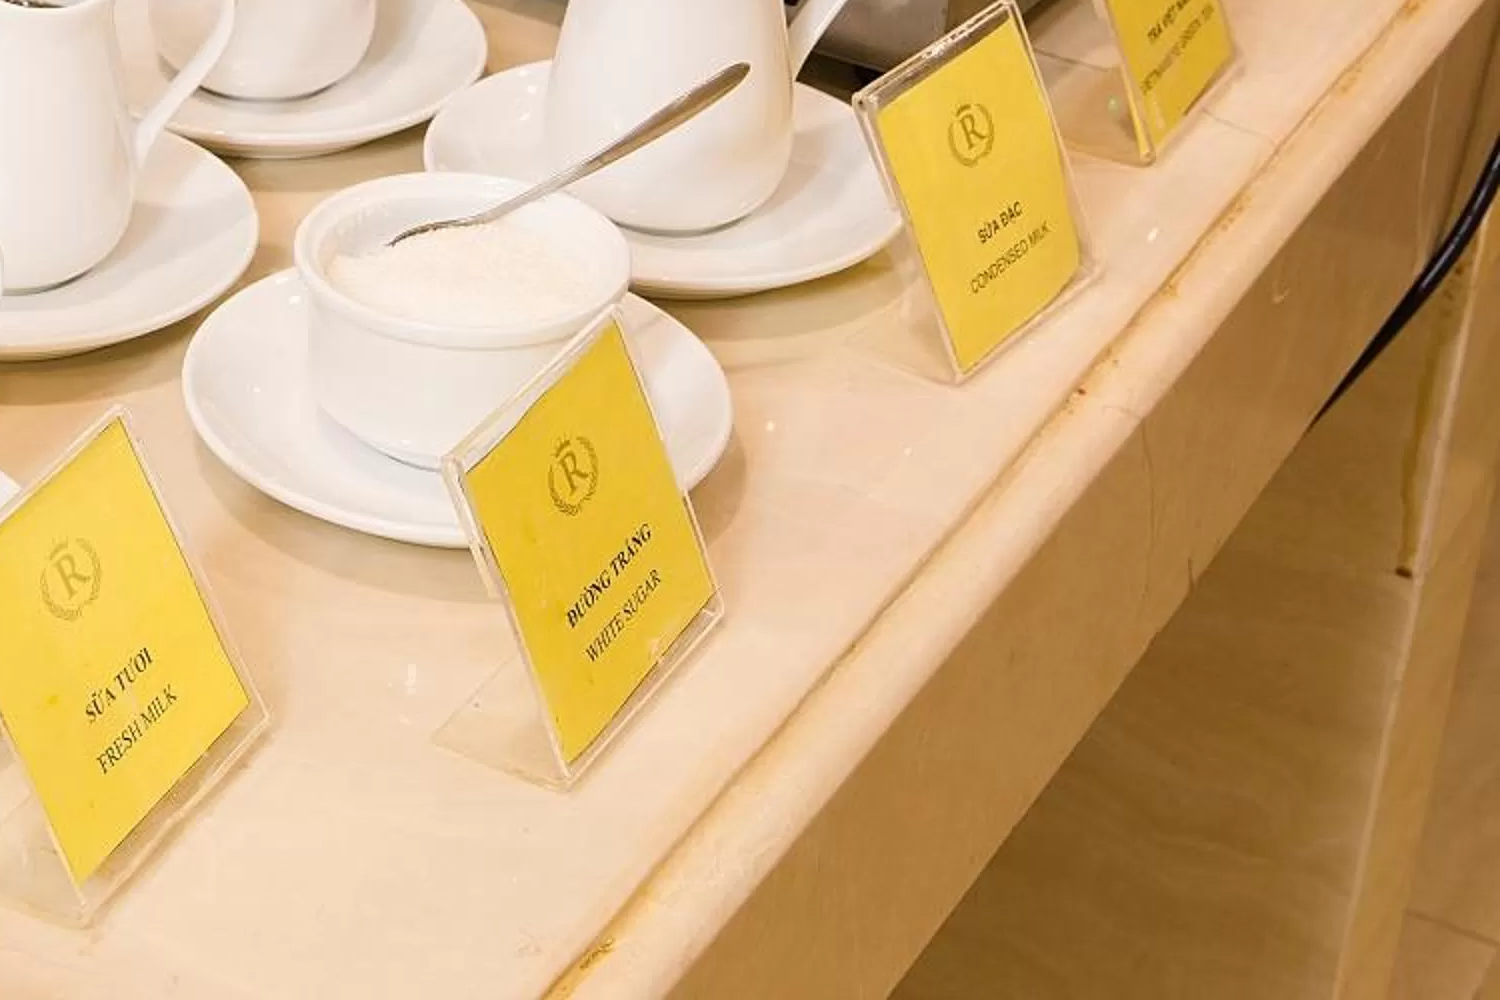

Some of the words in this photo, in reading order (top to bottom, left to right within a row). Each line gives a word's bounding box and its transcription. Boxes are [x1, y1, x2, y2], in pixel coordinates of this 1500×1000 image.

[970, 239, 1029, 294] CONDENSED
[559, 450, 588, 497] R
[56, 552, 92, 601] R
[585, 611, 625, 662] WHITE
[622, 568, 662, 622] SUGAR
[96, 719, 143, 775] FRESH
[140, 683, 178, 730] MILK
